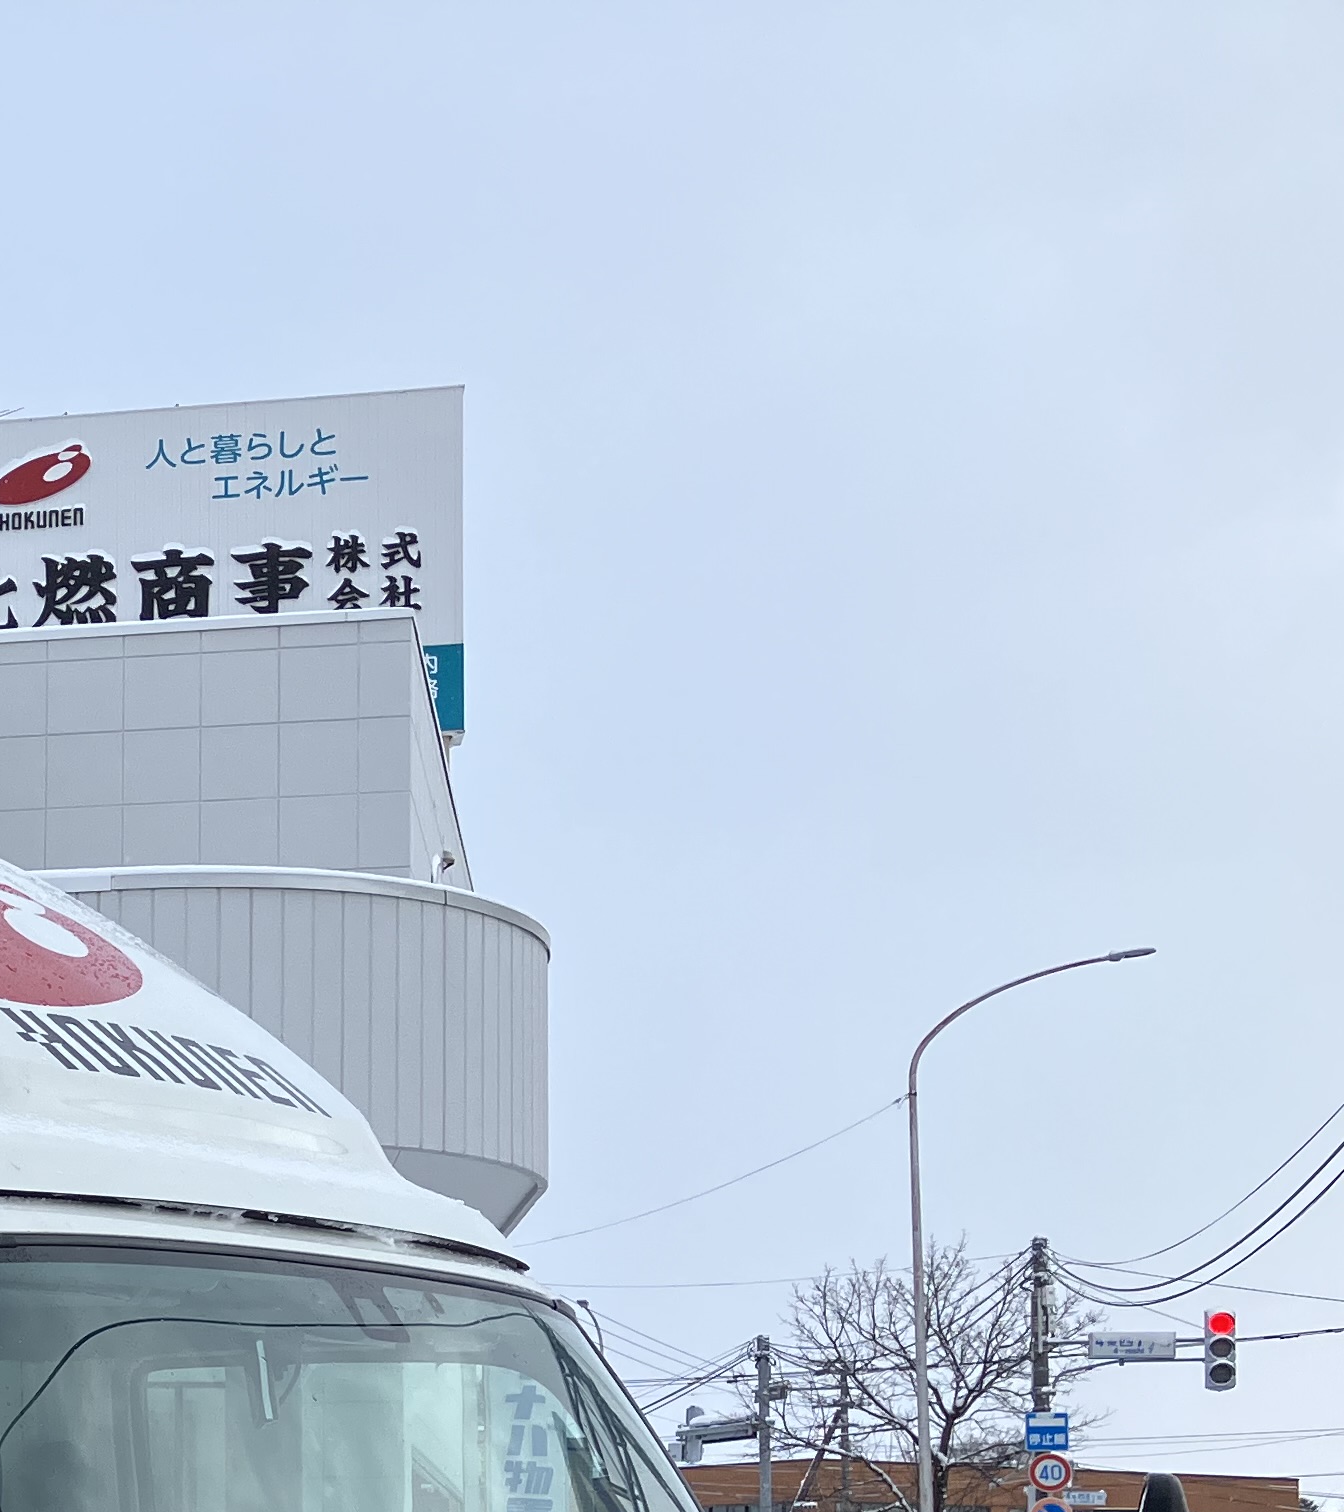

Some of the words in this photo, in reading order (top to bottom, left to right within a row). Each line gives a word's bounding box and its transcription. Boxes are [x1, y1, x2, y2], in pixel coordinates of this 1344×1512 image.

[145, 428, 337, 470] 人と暮らしと
[211, 464, 370, 500] エネルギー
[0, 1007, 332, 1118] HOKUNEN
[1039, 1464, 1063, 1482] 40
